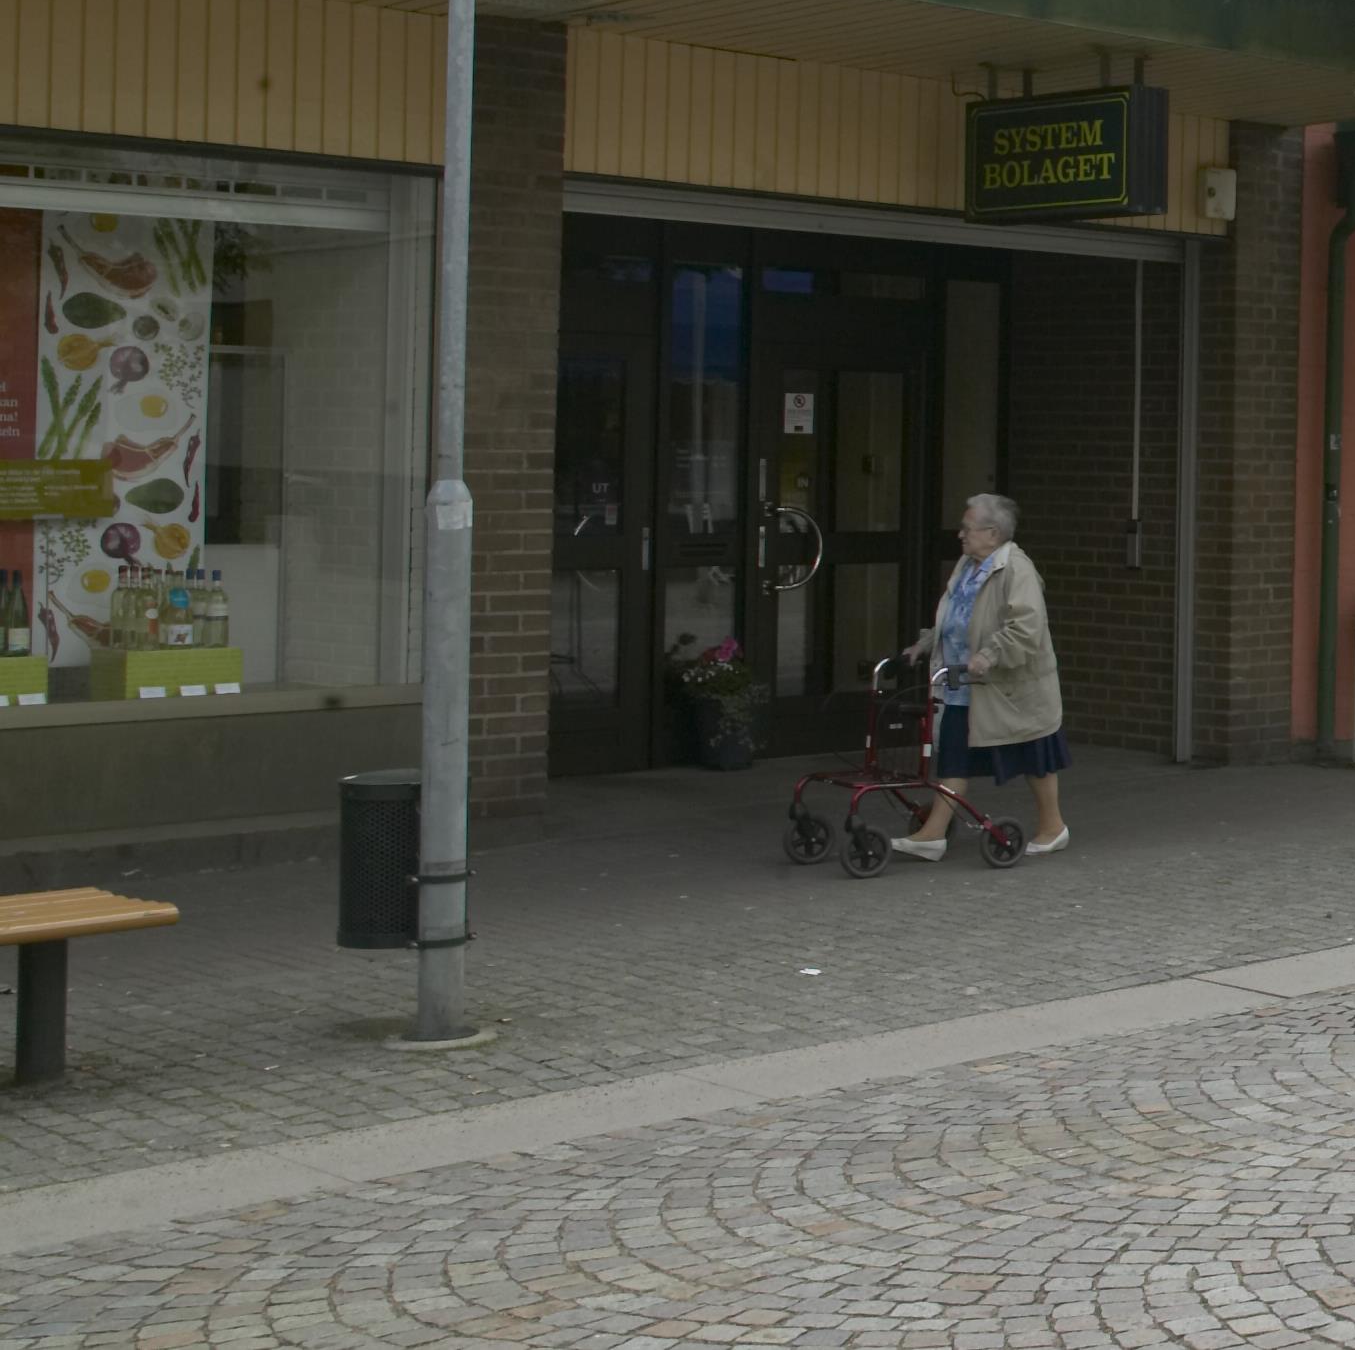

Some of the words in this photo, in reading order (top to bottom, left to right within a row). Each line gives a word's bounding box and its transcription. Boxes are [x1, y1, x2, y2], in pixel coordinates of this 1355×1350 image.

[993, 119, 1104, 155] SYSTEM
[983, 153, 1115, 189] BOLAGET
[592, 482, 609, 494] UT
